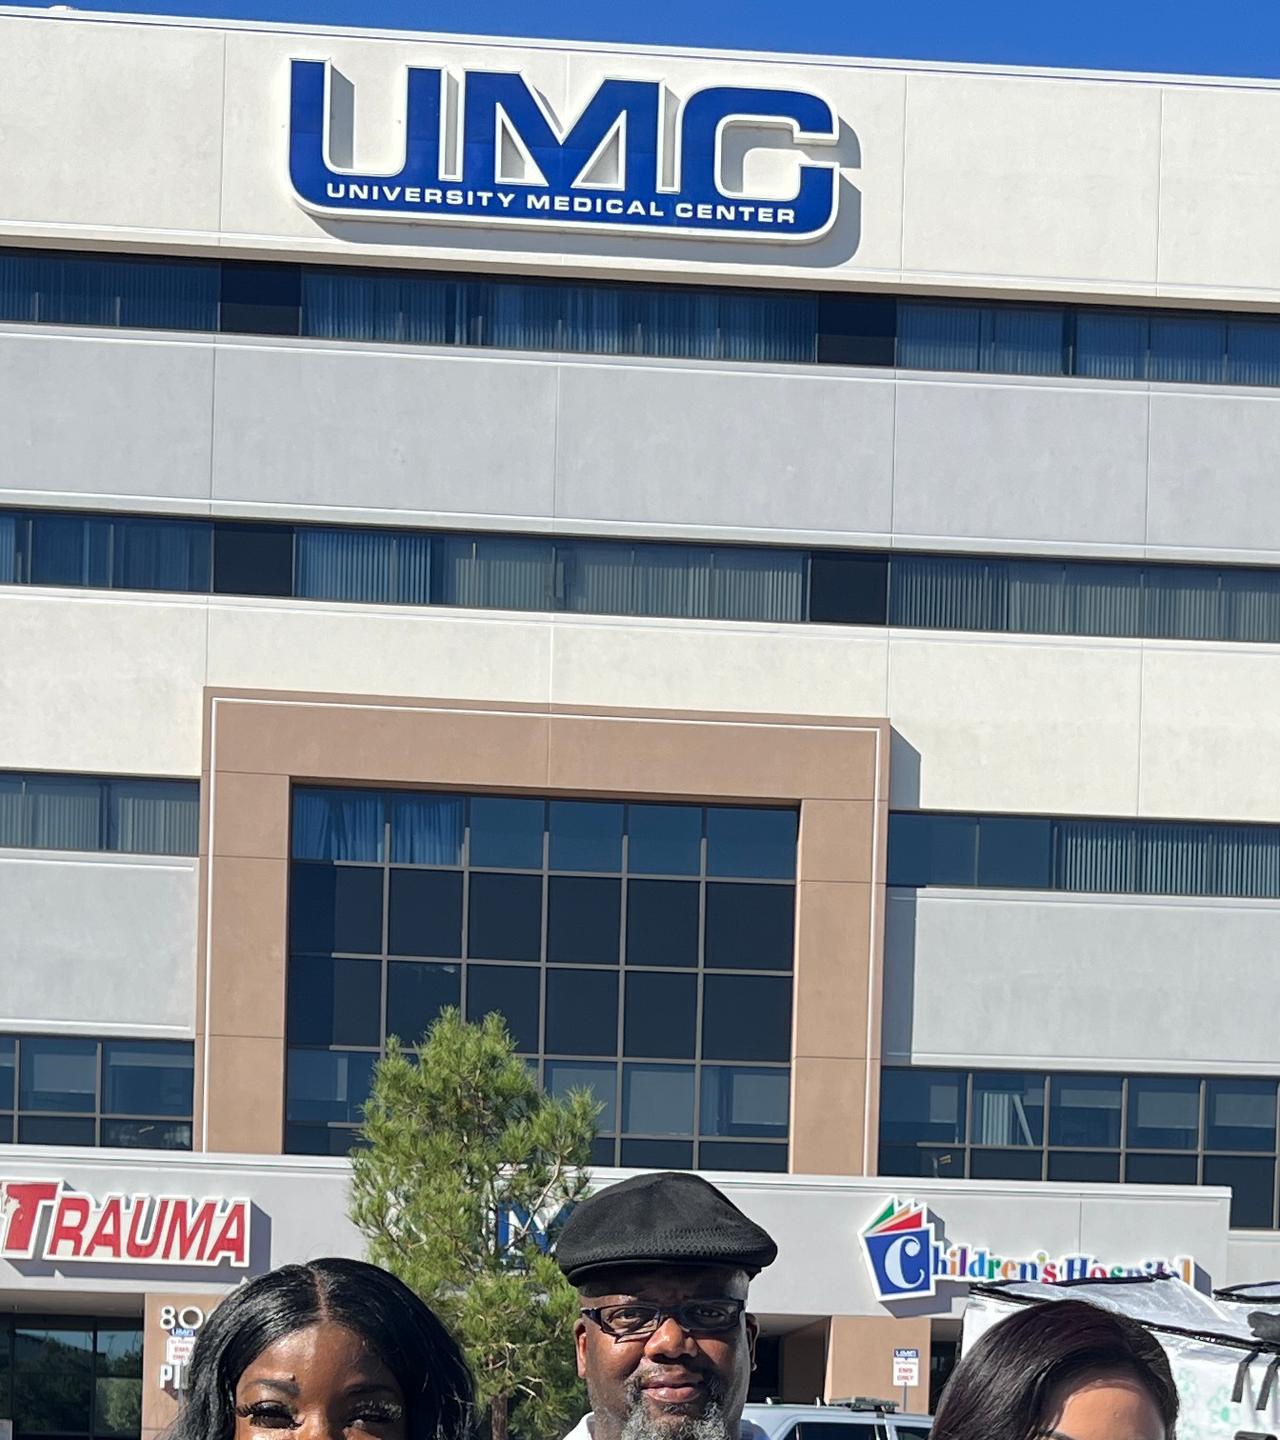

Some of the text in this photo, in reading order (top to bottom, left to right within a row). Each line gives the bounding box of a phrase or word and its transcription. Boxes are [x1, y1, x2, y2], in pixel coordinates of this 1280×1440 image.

[289, 58, 840, 237] UMC
[327, 183, 795, 223] UNIVERSITY MEDICAL CENTER
[883, 1235, 1058, 1289] Children's
[160, 1306, 215, 1330] 80
